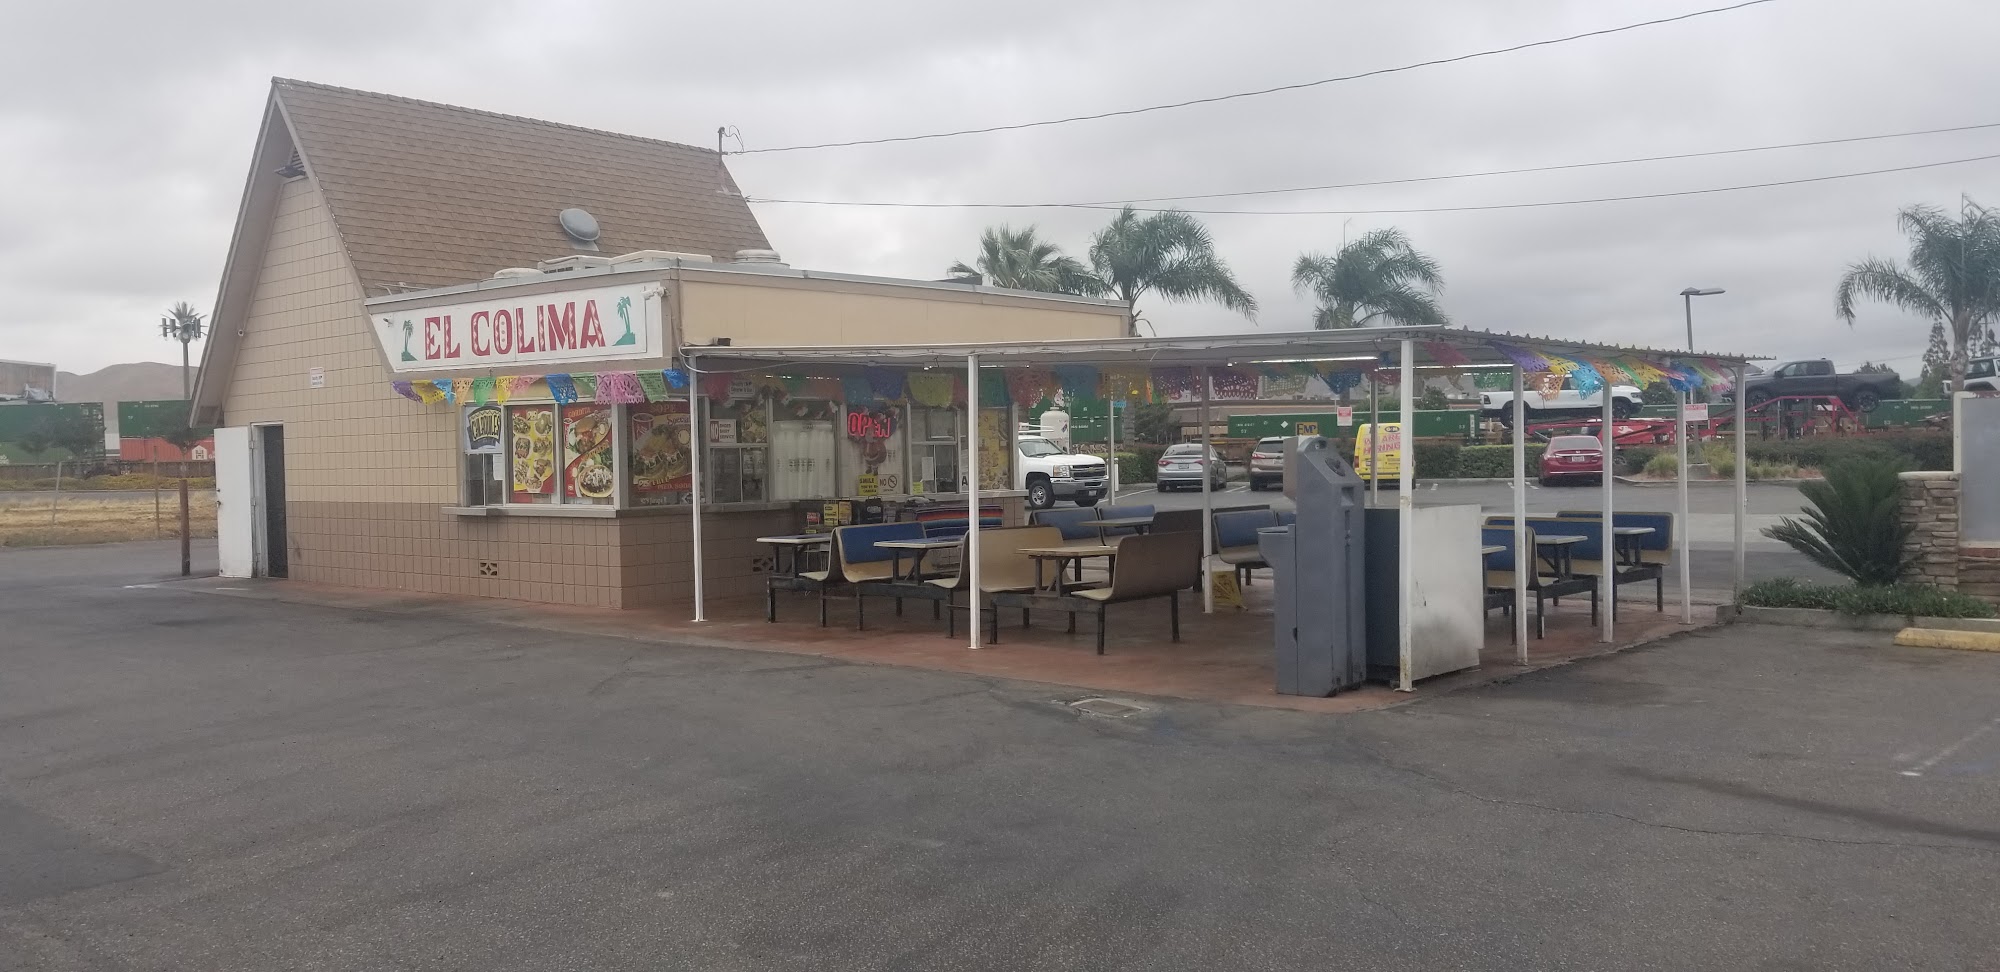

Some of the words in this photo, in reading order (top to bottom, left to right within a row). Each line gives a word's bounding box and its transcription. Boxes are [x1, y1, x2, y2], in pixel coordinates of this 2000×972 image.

[425, 315, 460, 360] EL
[471, 300, 606, 357] COLIMA
[711, 423, 719, 440] NO
[1383, 433, 1400, 443] ARE
[1363, 443, 1400, 455] HRING
[880, 479, 887, 487] NO
